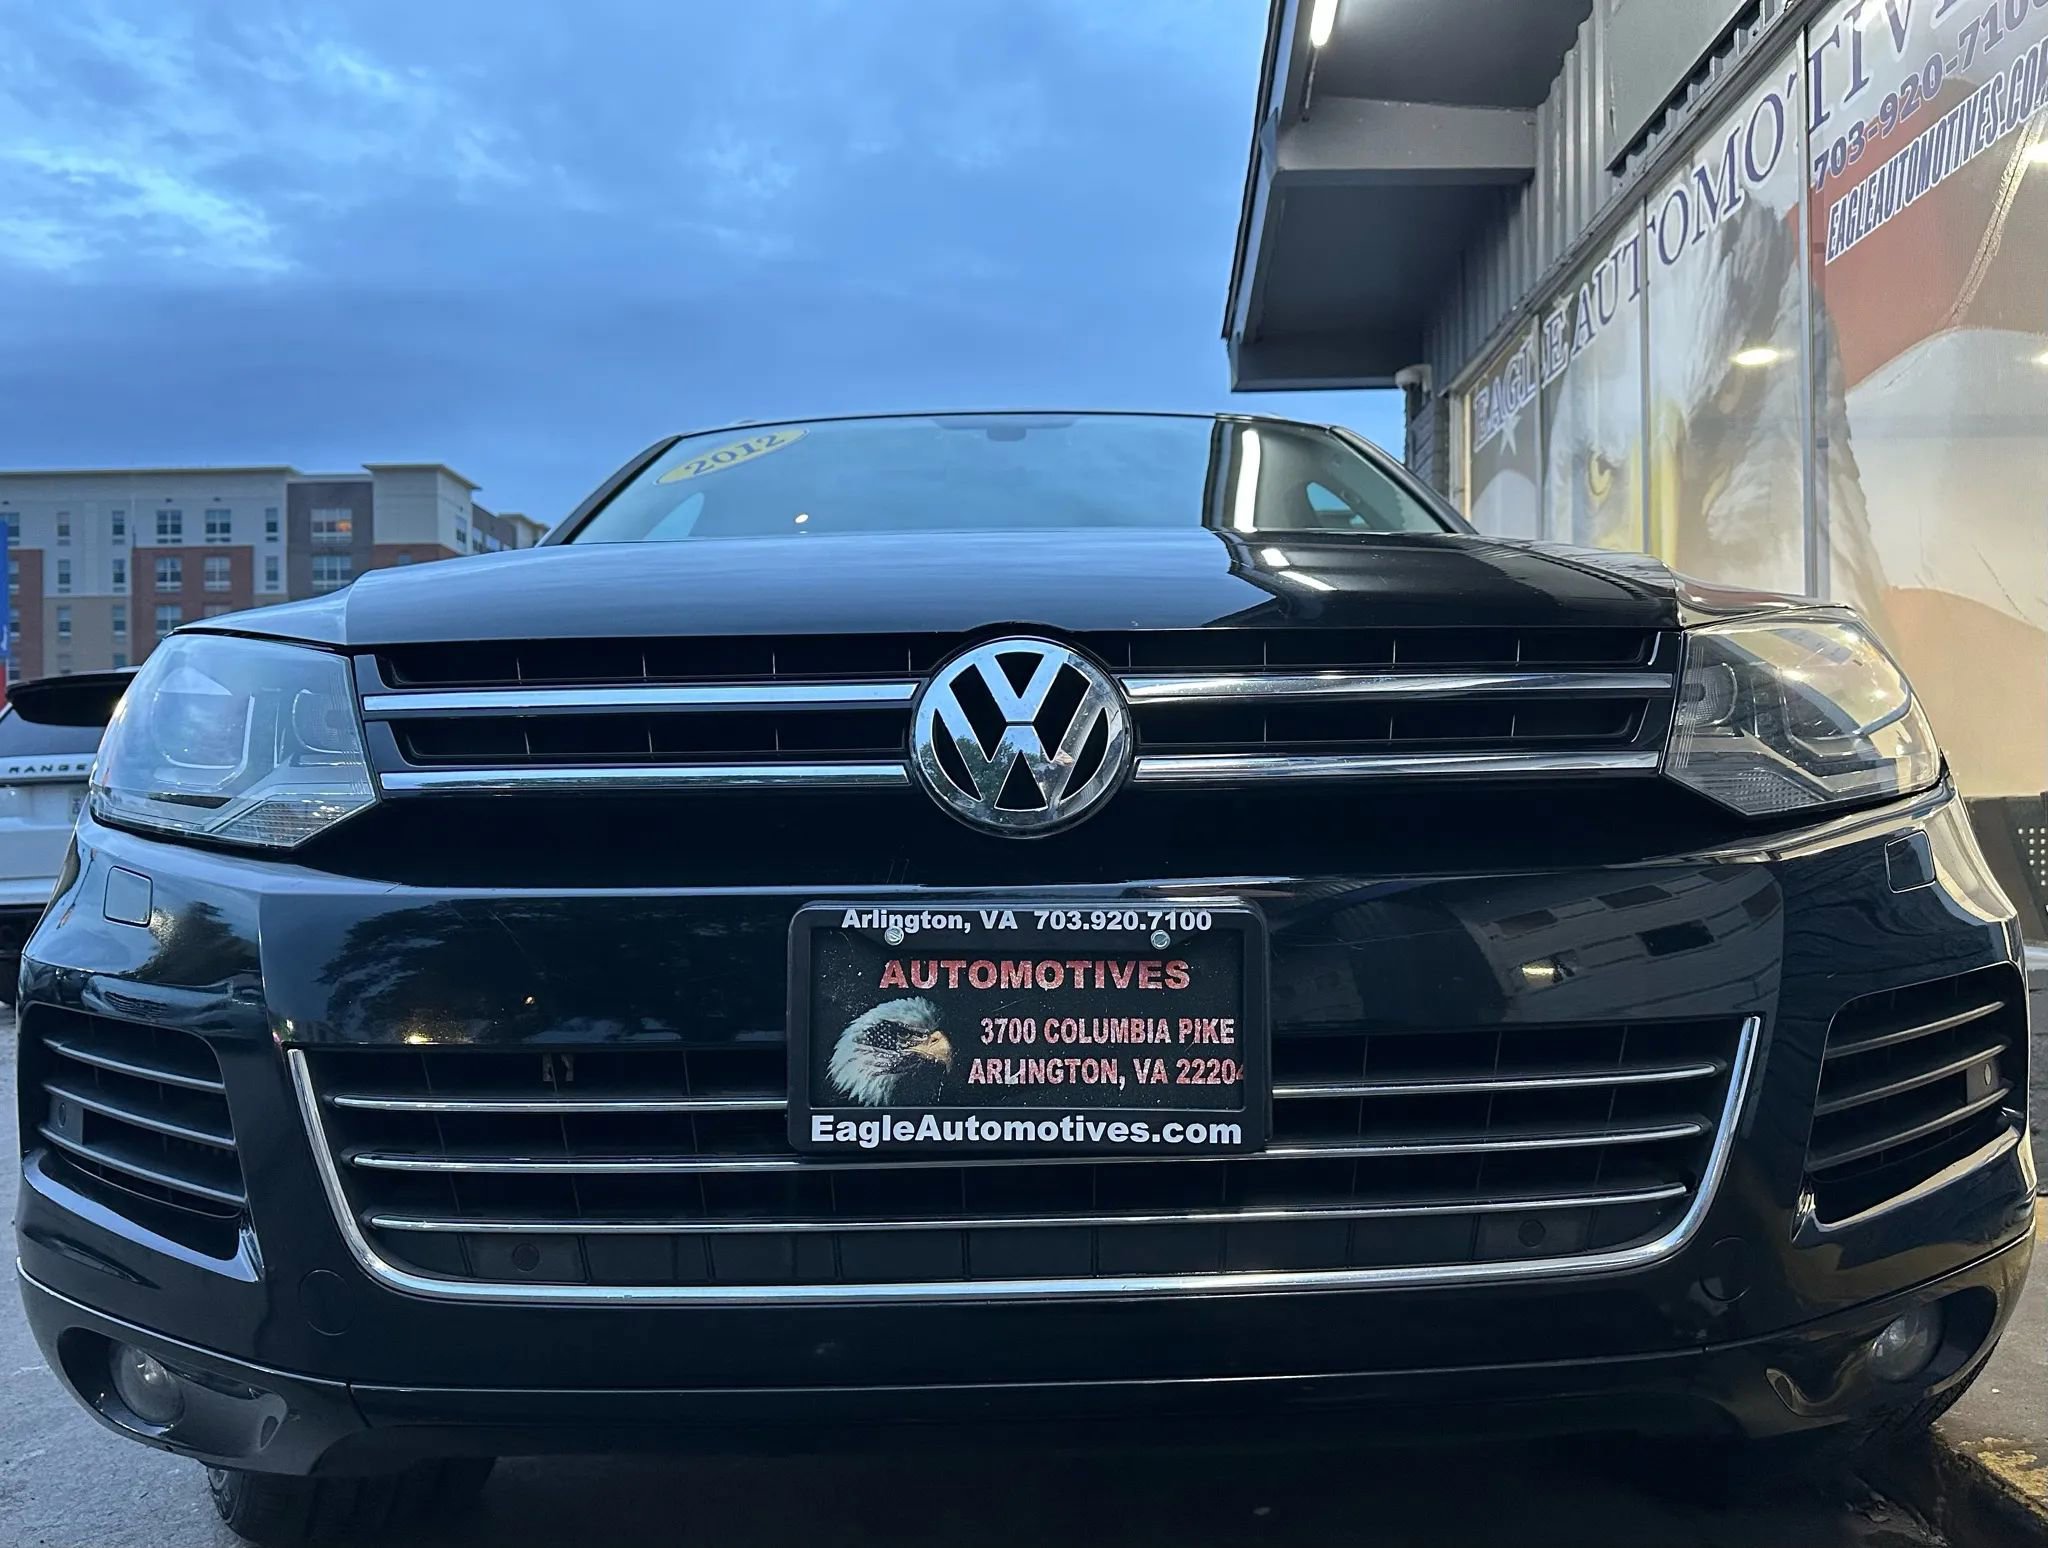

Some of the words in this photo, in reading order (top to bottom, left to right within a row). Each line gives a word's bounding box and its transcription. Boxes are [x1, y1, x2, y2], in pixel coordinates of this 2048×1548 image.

[1814, 0, 2048, 193] 703-920-710
[1474, 307, 1569, 453] EAGLE
[1572, 0, 1960, 355] AUTOMOTIV
[685, 434, 785, 474] 2012
[9, 764, 87, 773] RANGE
[842, 908, 971, 934] Arlington,
[979, 911, 1018, 930] VA
[1034, 911, 1212, 931] 703.920.7100
[879, 959, 1191, 991] AUTOMOTIVES
[980, 1018, 1036, 1045] 3700
[1043, 1018, 1171, 1044] COLUMBIA
[1178, 1018, 1235, 1044] PIKE
[967, 1058, 1126, 1090] ARLINGTON,
[1133, 1058, 1168, 1084] VA
[811, 1114, 1242, 1149] EagleAutomotives.com
